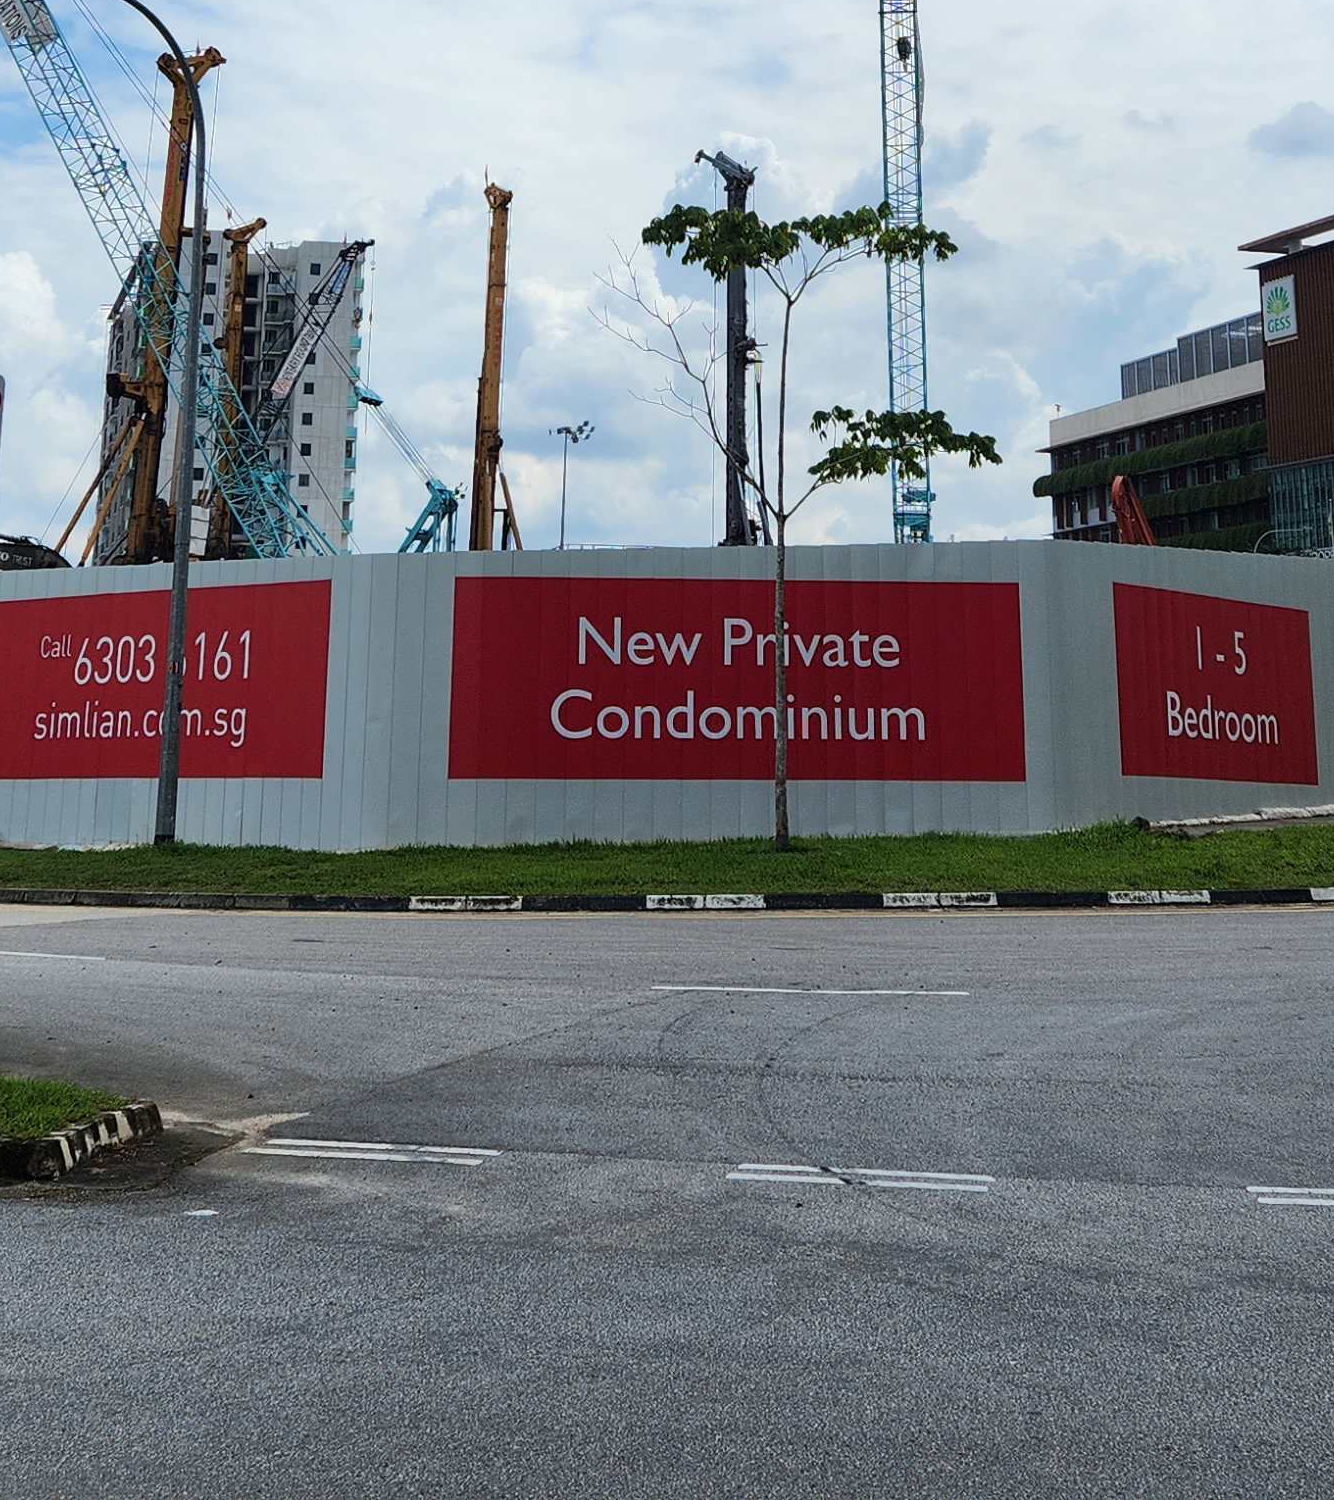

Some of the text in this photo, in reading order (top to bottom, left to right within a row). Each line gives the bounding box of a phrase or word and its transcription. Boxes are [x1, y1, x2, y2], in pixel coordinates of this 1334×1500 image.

[1267, 316, 1291, 333] GESS
[41, 630, 250, 684] Call 6303 161
[578, 617, 900, 667] New Private
[34, 700, 246, 747] simlian.cm.sg
[550, 689, 925, 740] Condominium
[1167, 690, 1278, 744] Bedroom
